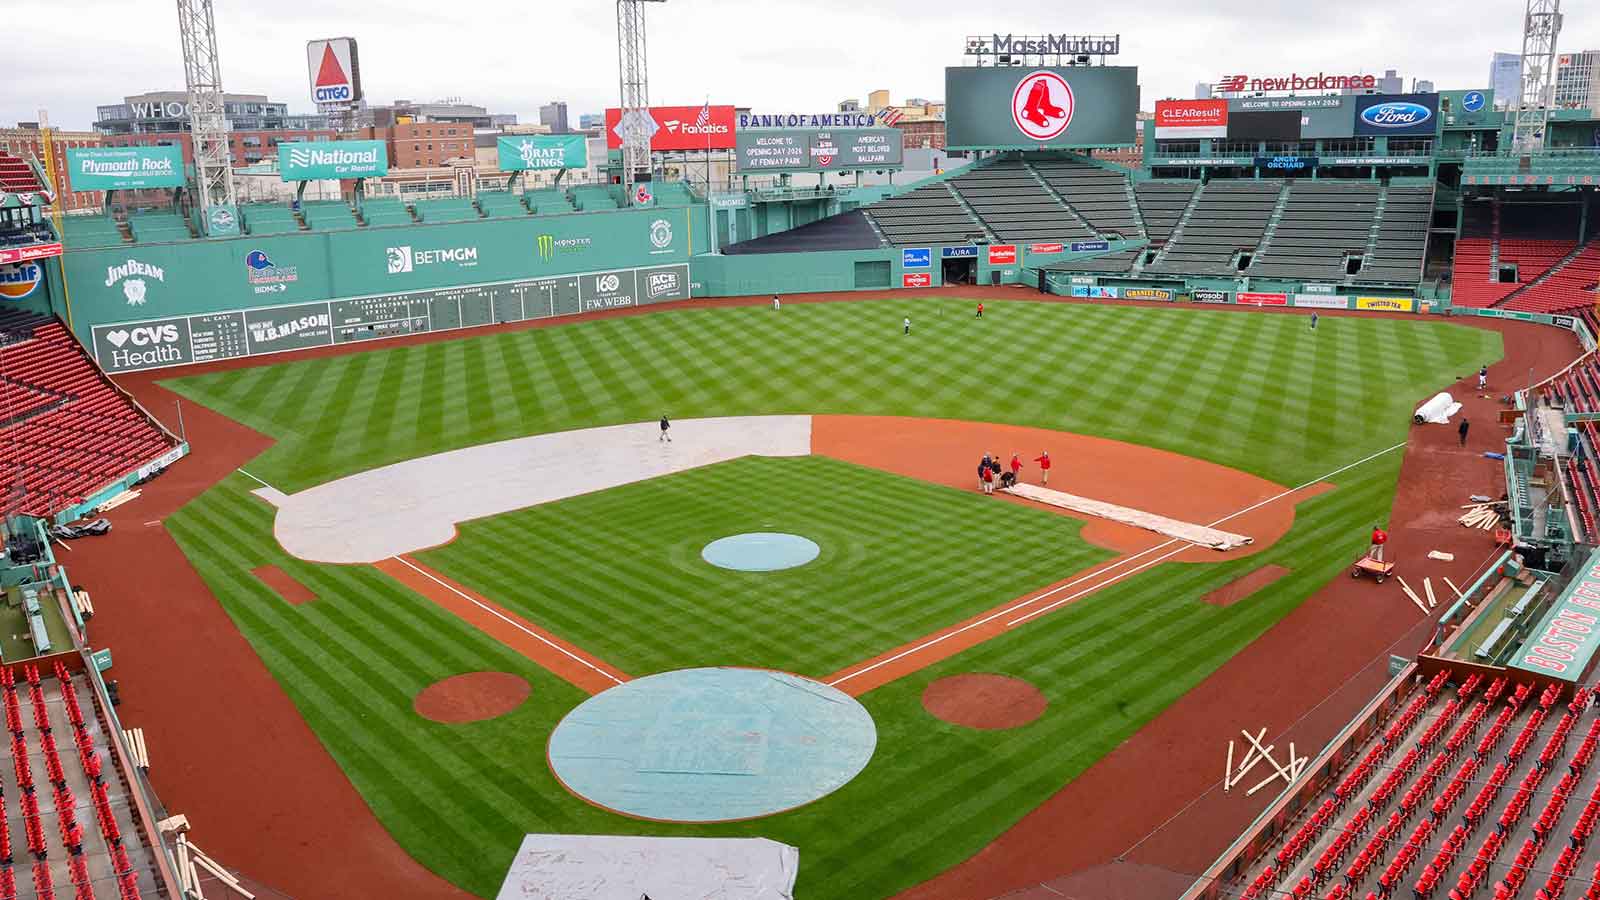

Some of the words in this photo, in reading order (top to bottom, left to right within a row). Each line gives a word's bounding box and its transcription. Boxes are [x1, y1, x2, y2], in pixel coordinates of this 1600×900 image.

[993, 34, 1120, 54] MassMutual
[1251, 77, 1290, 91] new
[1292, 73, 1375, 91] balance
[315, 86, 349, 101] CITGO
[1280, 100, 1306, 108] OPENING
[1162, 108, 1221, 118] CLEAResult
[1375, 105, 1417, 123] Ford
[740, 114, 782, 128] BANK
[787, 114, 806, 127] OF
[810, 114, 875, 127] AMERICA
[682, 122, 728, 135] Fanatics
[756, 137, 783, 145] WELCOME
[310, 147, 377, 165] National
[526, 158, 564, 168] KINGS
[760, 158, 784, 166] FENWAY
[785, 157, 801, 165] PARK
[81, 158, 139, 174] Plymouth
[142, 156, 172, 171] Rock
[335, 165, 350, 173] Car
[350, 164, 376, 173] Rental
[415, 247, 478, 265] BETMGM
[105, 264, 129, 287] JIM
[126, 259, 165, 283] BEAM
[652, 273, 676, 286] ACE
[1126, 289, 1154, 297] GRANITE
[1154, 289, 1169, 299] CITY
[1196, 291, 1224, 299] wasabi
[604, 296, 632, 308] WEBB
[130, 324, 180, 346] CVS
[112, 344, 182, 368] Health
[1524, 609, 1597, 672] BOSTON
